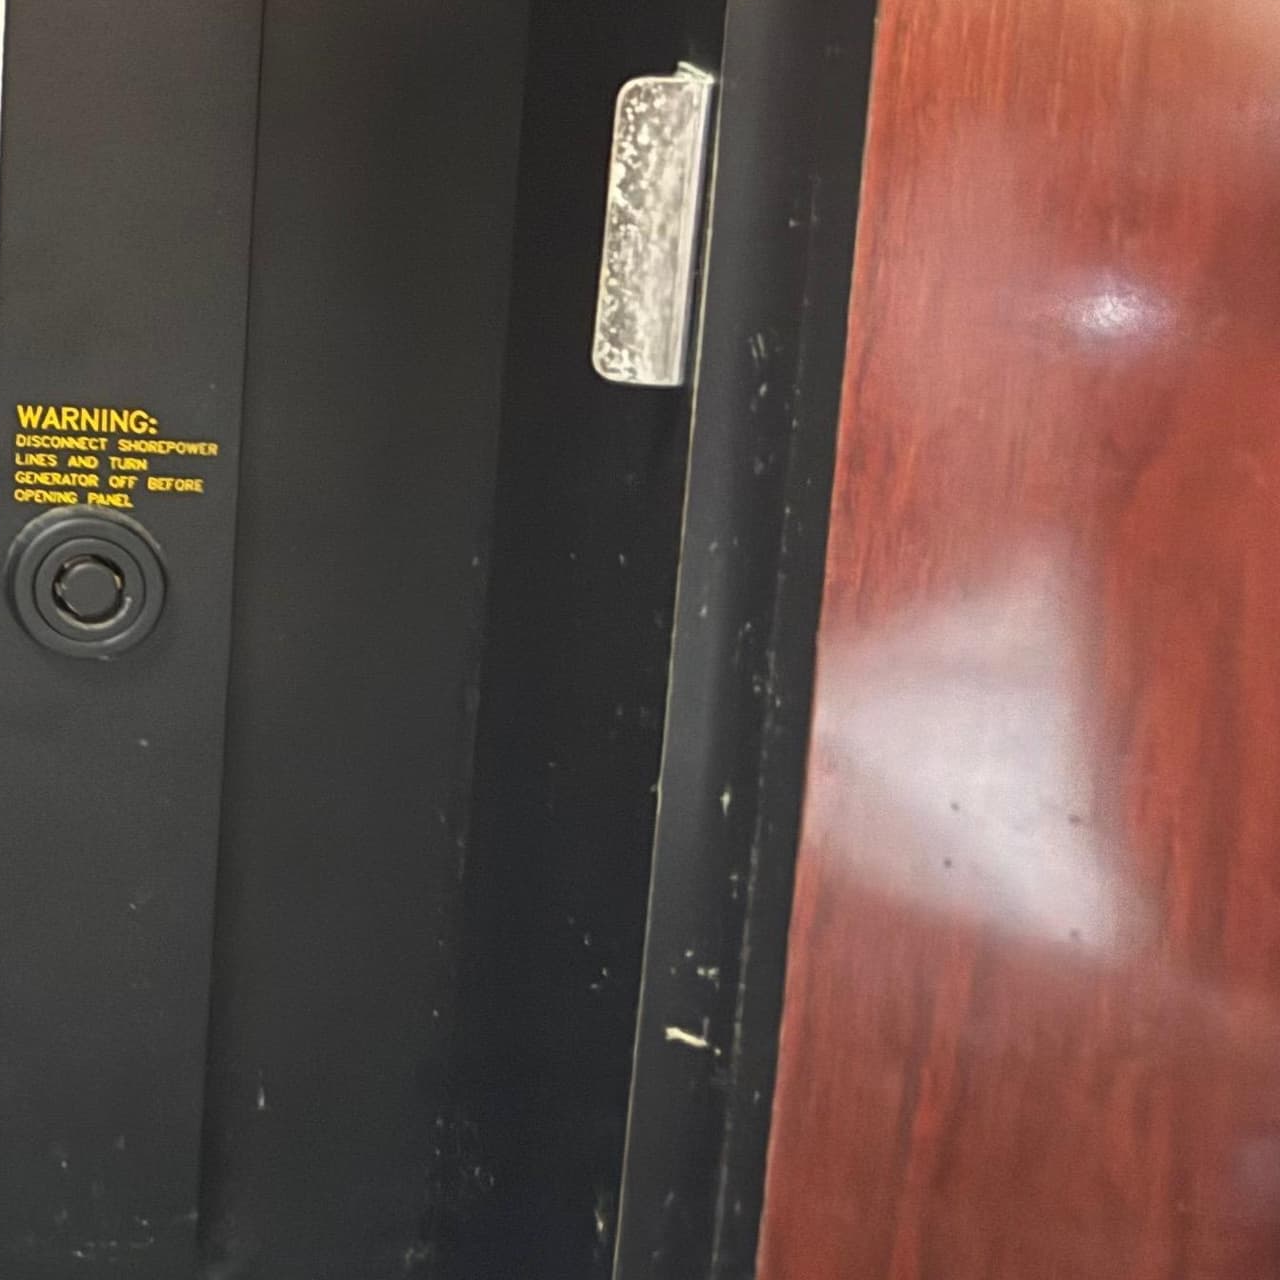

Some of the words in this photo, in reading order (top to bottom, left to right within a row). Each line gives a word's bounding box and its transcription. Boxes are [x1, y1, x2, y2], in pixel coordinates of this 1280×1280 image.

[17, 405, 157, 434] WARNING:
[16, 434, 108, 450] DISCONNECT
[118, 439, 218, 455] SHOREPOWER
[16, 453, 57, 467] LINES
[68, 456, 98, 469] AND
[109, 457, 147, 470] TURN
[15, 471, 99, 487] GENERATOR
[109, 476, 138, 488] OFF
[148, 477, 203, 492] BEFORE
[14, 489, 77, 504] OPENING
[87, 492, 134, 508] PANEL
